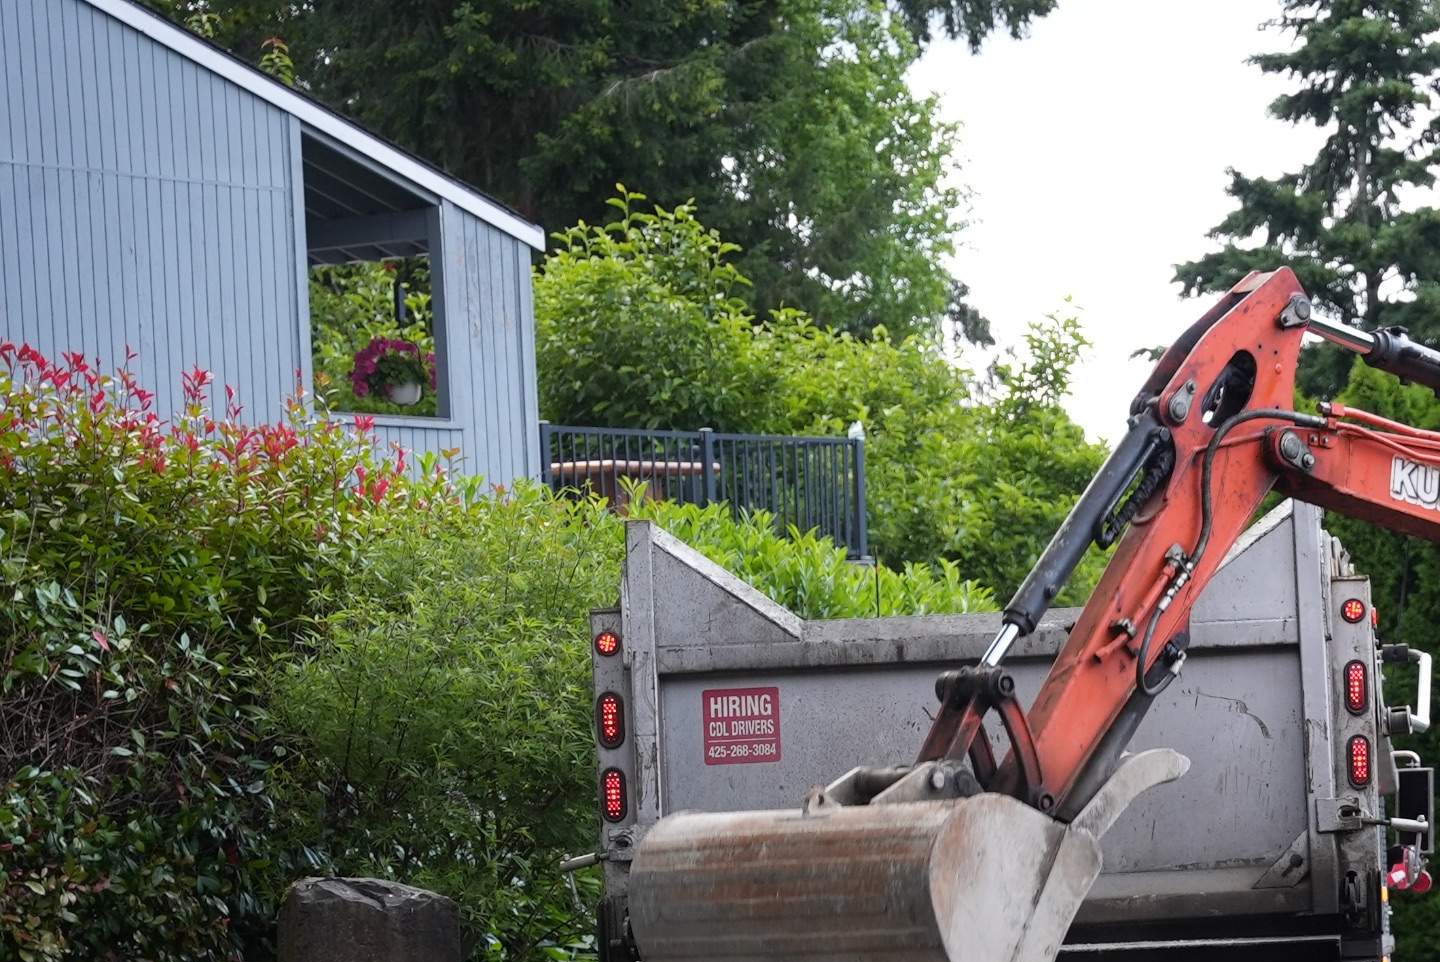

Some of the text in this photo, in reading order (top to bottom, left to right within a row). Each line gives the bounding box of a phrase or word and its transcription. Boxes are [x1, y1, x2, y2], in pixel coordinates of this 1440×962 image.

[709, 694, 772, 718] HIRING
[709, 719, 774, 737] CDL DRIVERS
[708, 743, 776, 758] 425-268-3084
